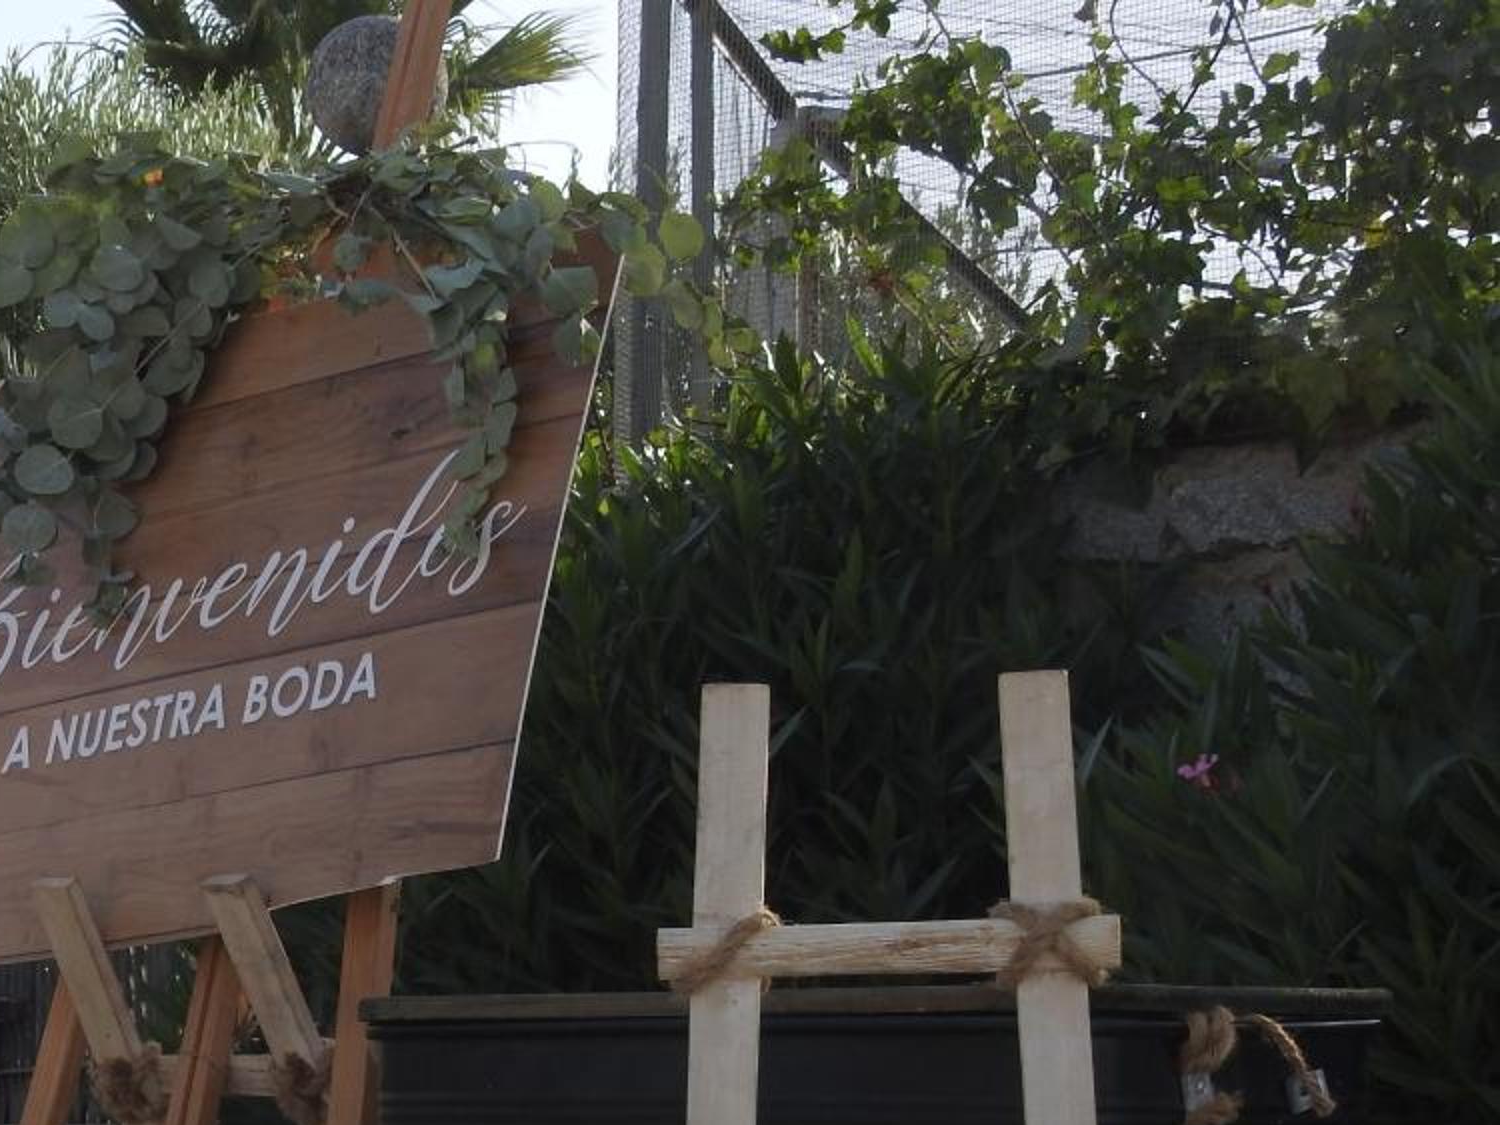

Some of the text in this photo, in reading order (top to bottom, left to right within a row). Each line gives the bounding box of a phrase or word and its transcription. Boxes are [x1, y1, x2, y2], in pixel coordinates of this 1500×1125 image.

[1, 652, 377, 775] A NUESTRA BODA
